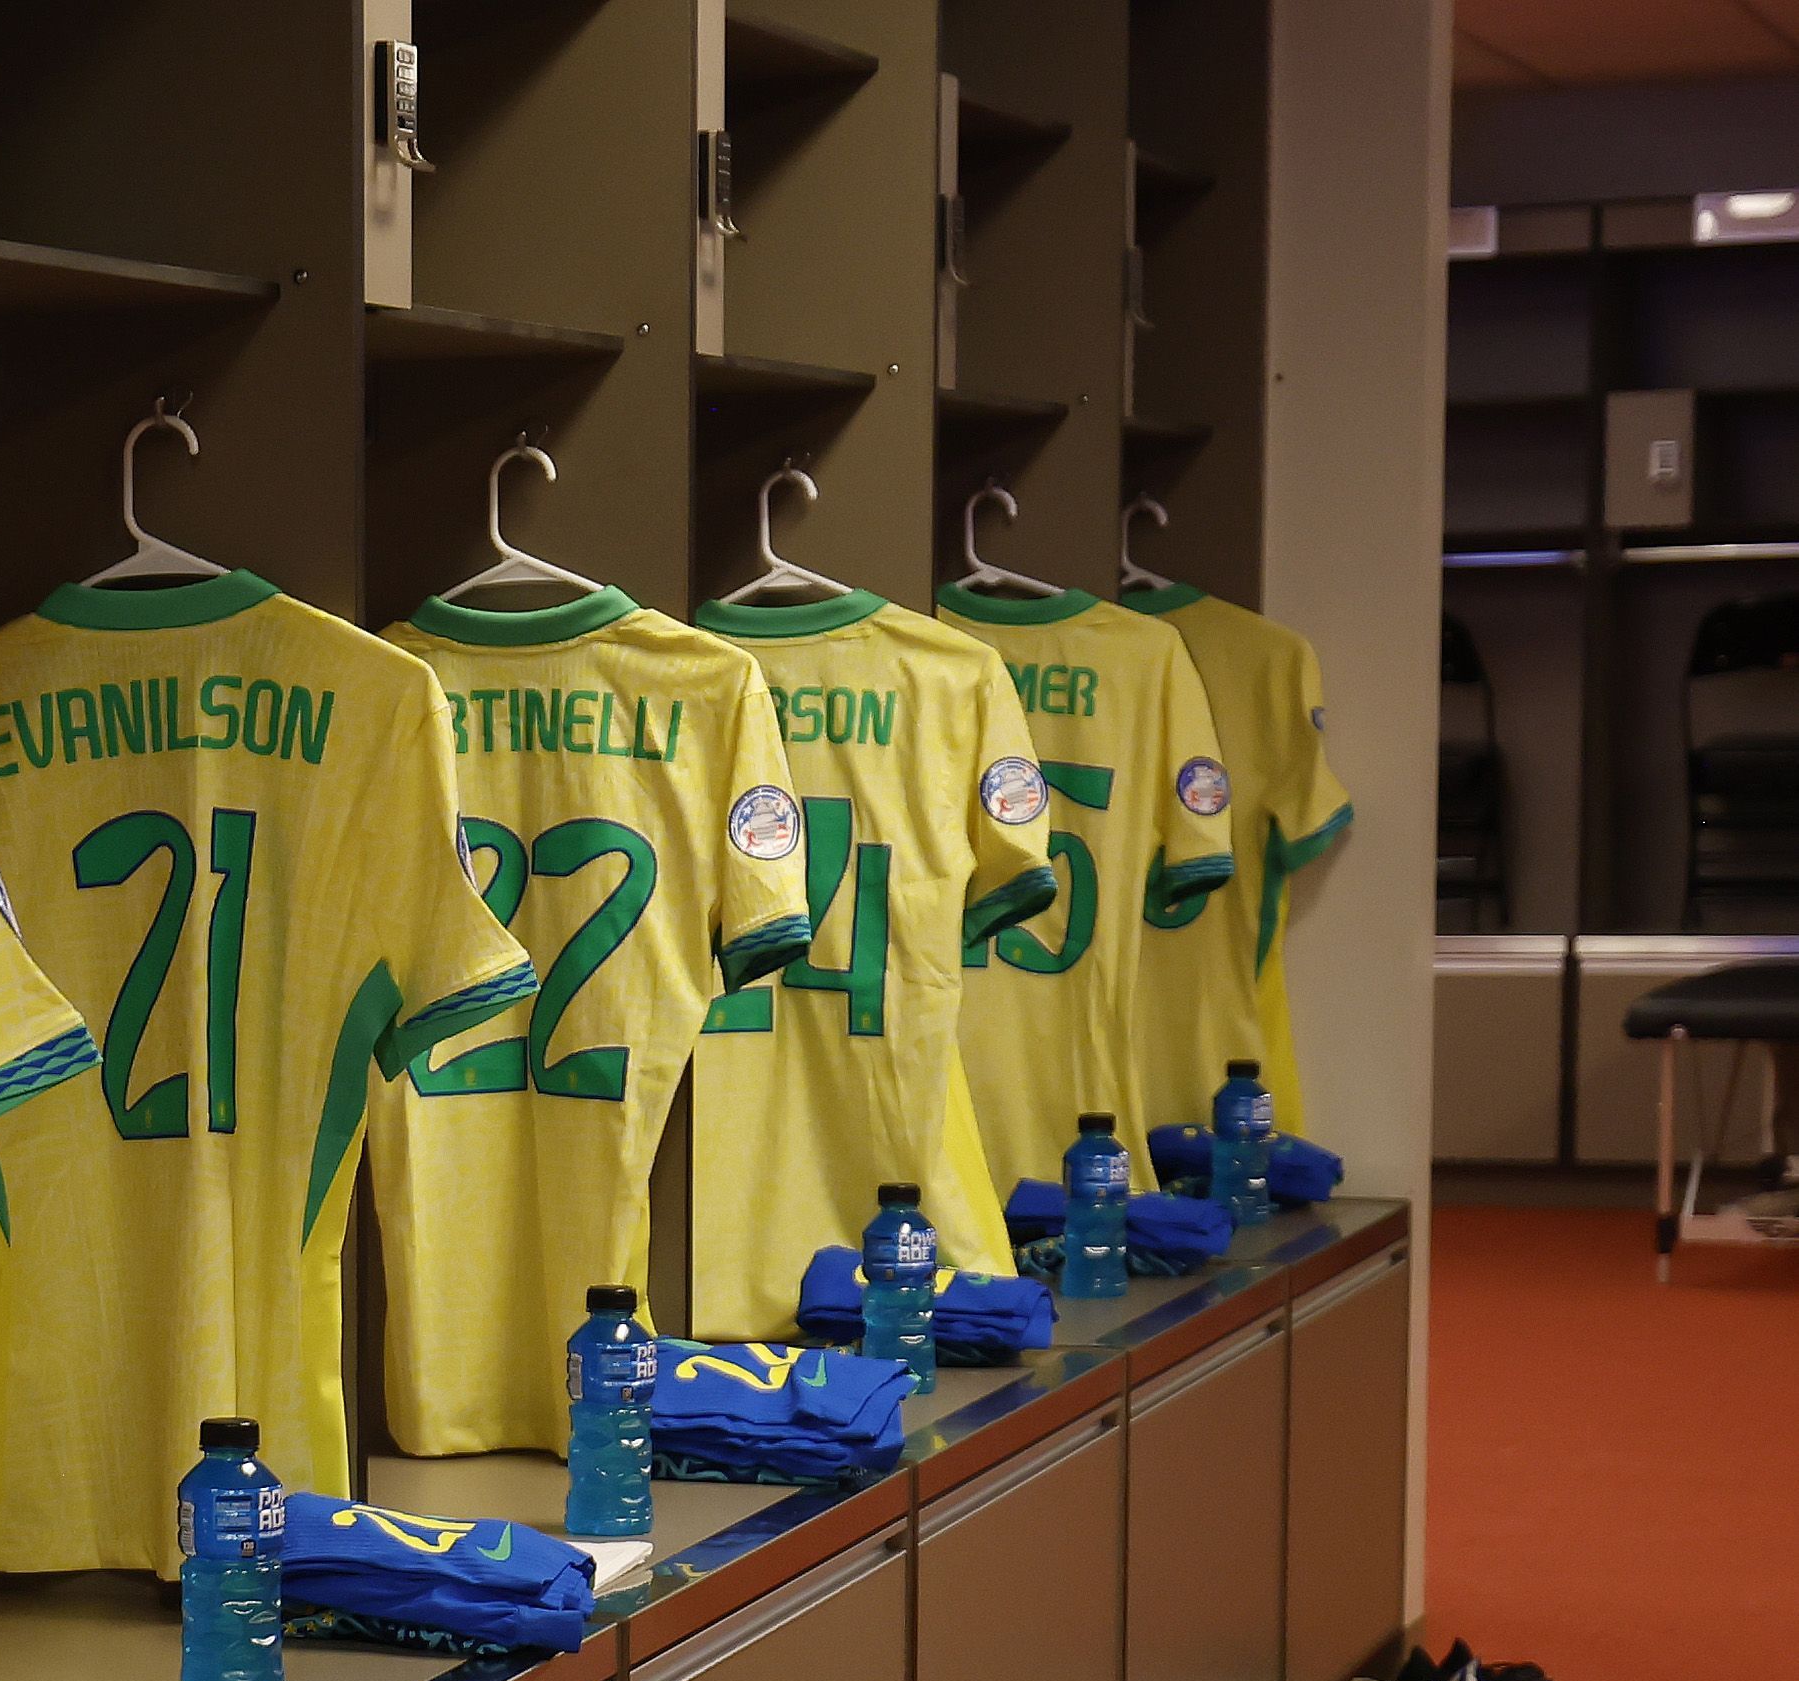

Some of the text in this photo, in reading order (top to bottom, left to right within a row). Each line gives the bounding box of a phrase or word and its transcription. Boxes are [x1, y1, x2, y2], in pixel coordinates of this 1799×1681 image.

[1005, 664, 1098, 716] MER
[444, 689, 683, 763] RTINELLI
[72, 810, 257, 1139] 21
[331, 1503, 477, 1555] 21
